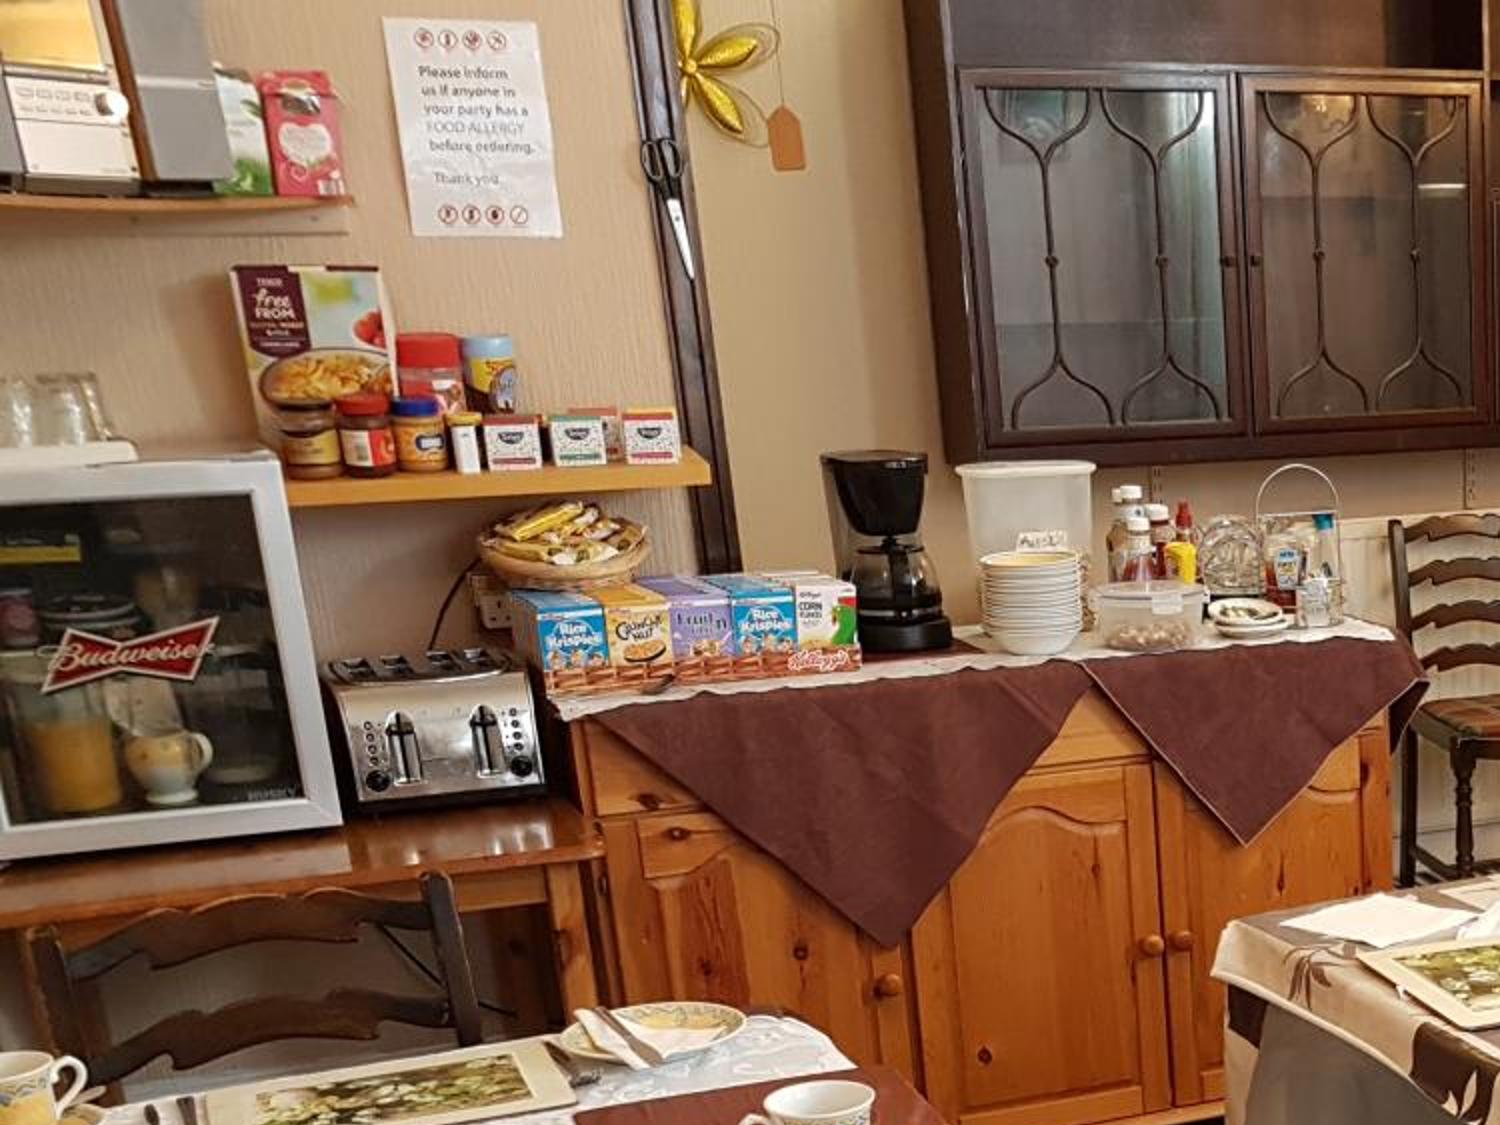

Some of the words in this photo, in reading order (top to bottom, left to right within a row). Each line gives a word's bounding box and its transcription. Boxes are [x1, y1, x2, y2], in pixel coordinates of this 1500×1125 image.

[418, 65, 461, 79] Please
[463, 65, 509, 80] inform
[421, 86, 437, 97] us
[439, 84, 448, 97] if
[451, 87, 499, 99] anyone
[502, 85, 516, 98] in
[423, 104, 455, 118] your
[457, 105, 493, 118] party
[495, 104, 518, 117] has
[520, 107, 529, 117] a
[426, 121, 465, 134] FOOD
[467, 121, 524, 136] ALLERGY
[429, 138, 472, 152] before
[434, 171, 472, 184] Thank
[798, 601, 823, 611] CORN
[751, 609, 780, 620] Rice
[559, 622, 588, 634] Rice
[740, 619, 793, 632] Krispies
[546, 632, 602, 647] Krispies
[47, 638, 214, 673] Budweiser
[787, 650, 851, 672] Kellogg's
